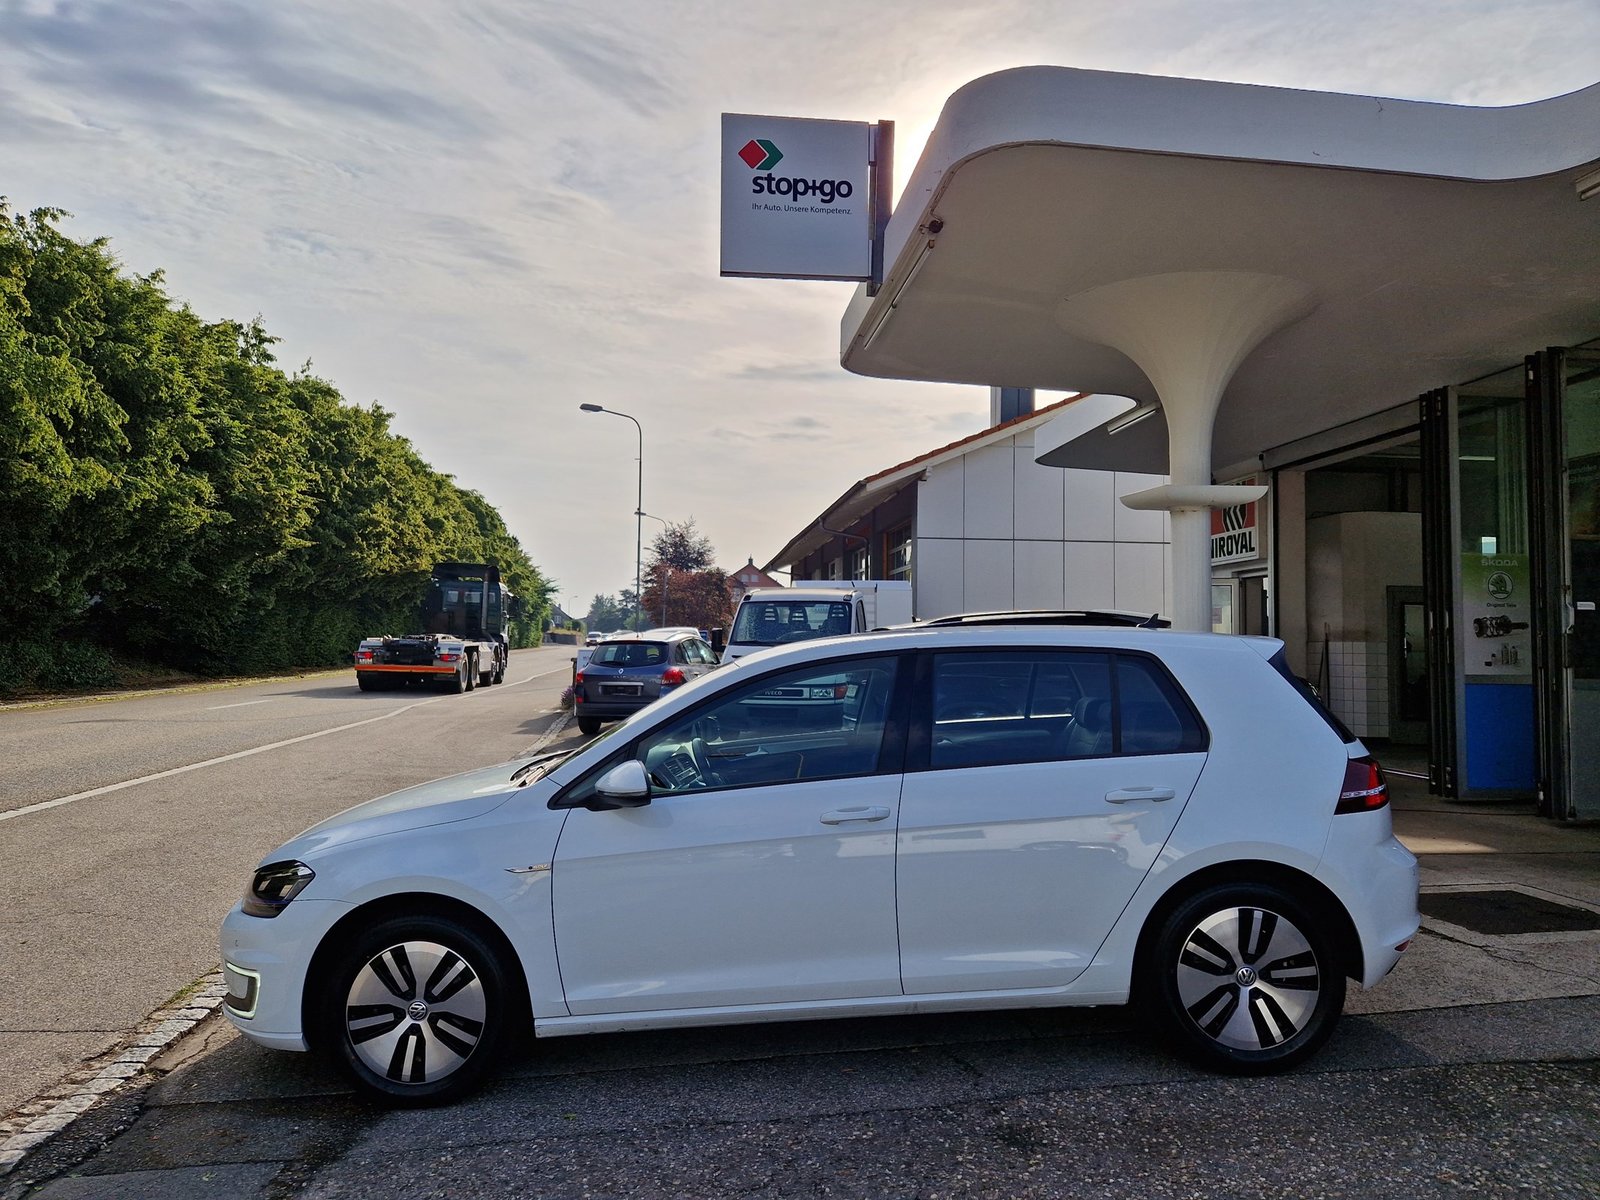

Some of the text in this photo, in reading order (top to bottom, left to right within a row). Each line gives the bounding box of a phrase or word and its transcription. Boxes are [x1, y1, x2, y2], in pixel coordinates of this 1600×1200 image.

[752, 173, 853, 203] stop+go
[784, 205, 809, 213] Unsere
[810, 206, 853, 215] Kompetenz.
